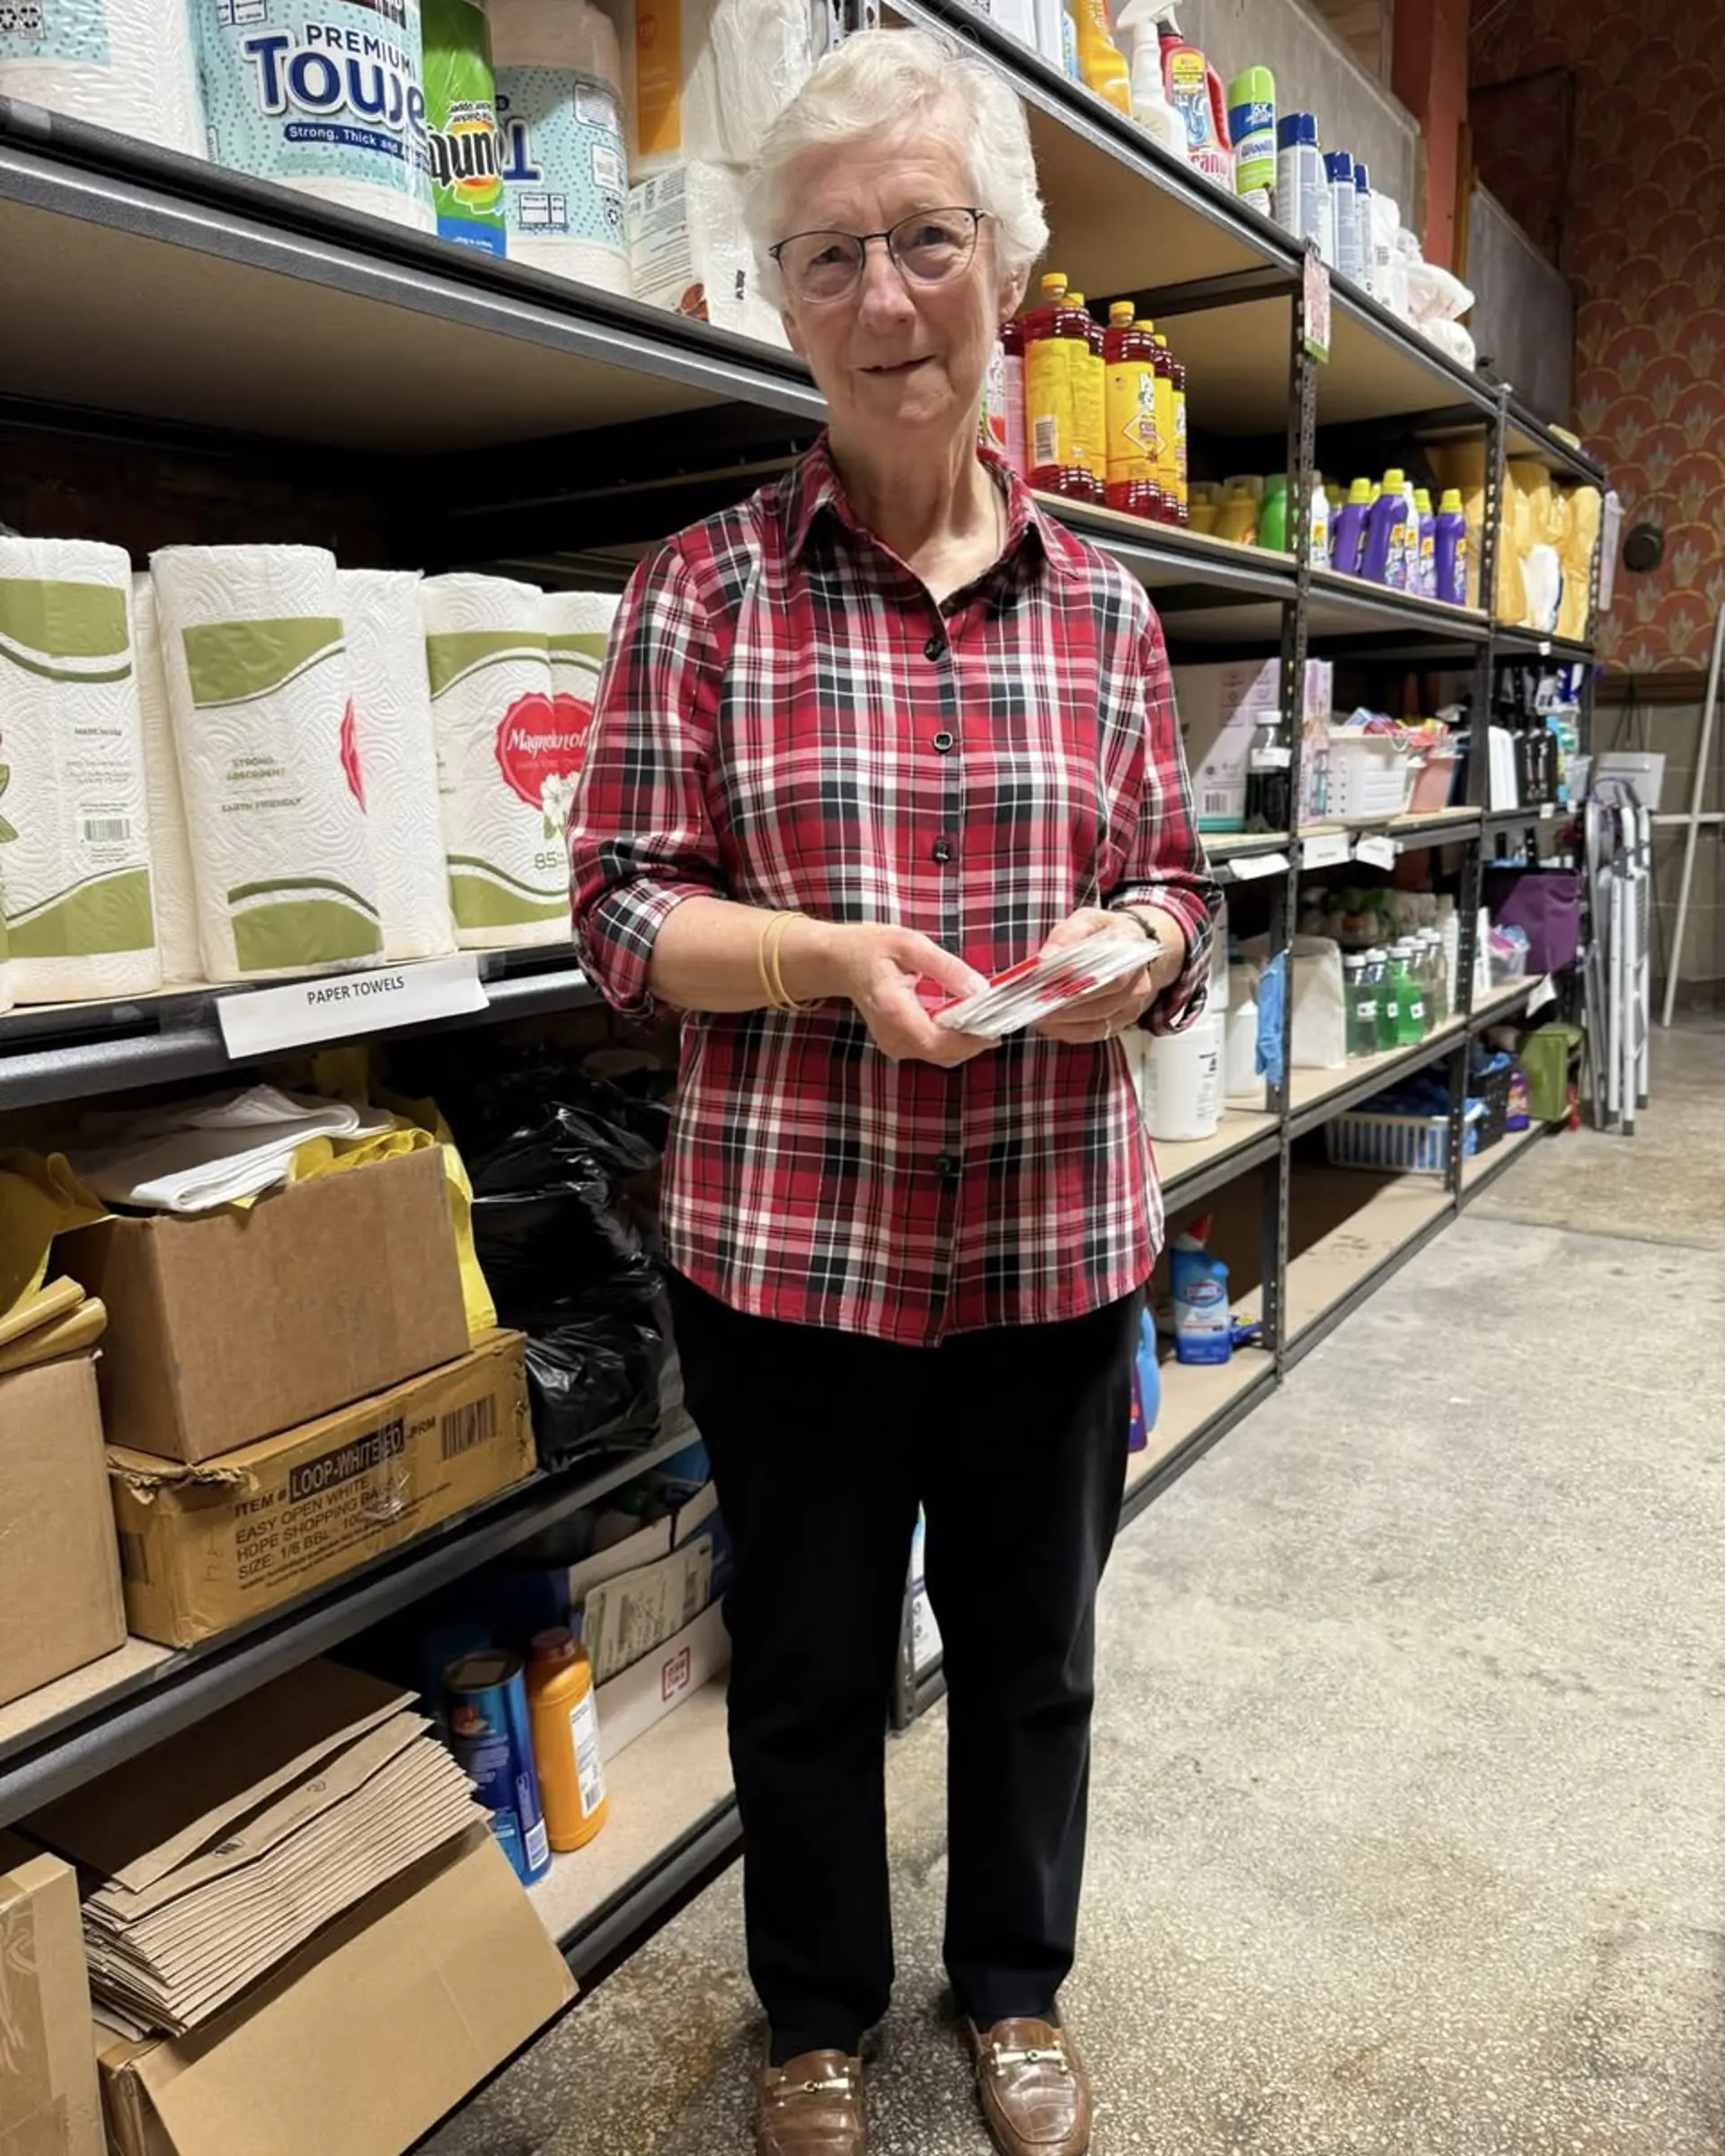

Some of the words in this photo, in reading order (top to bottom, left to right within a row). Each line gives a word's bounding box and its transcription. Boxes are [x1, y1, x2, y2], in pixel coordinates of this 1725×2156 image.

[305, 24, 417, 79] PREMIUM
[343, 128, 377, 146] Thick
[534, 851, 558, 870] 85
[306, 985, 351, 1005] PAPER
[351, 975, 406, 996] TOWELS
[234, 1493, 274, 1518] ITEM
[235, 1515, 278, 1544] EASY
[280, 1498, 323, 1525] OPEN
[326, 1477, 369, 1506] WHITE
[236, 1532, 280, 1563] HDPE
[282, 1498, 358, 1542] SHOPPING
